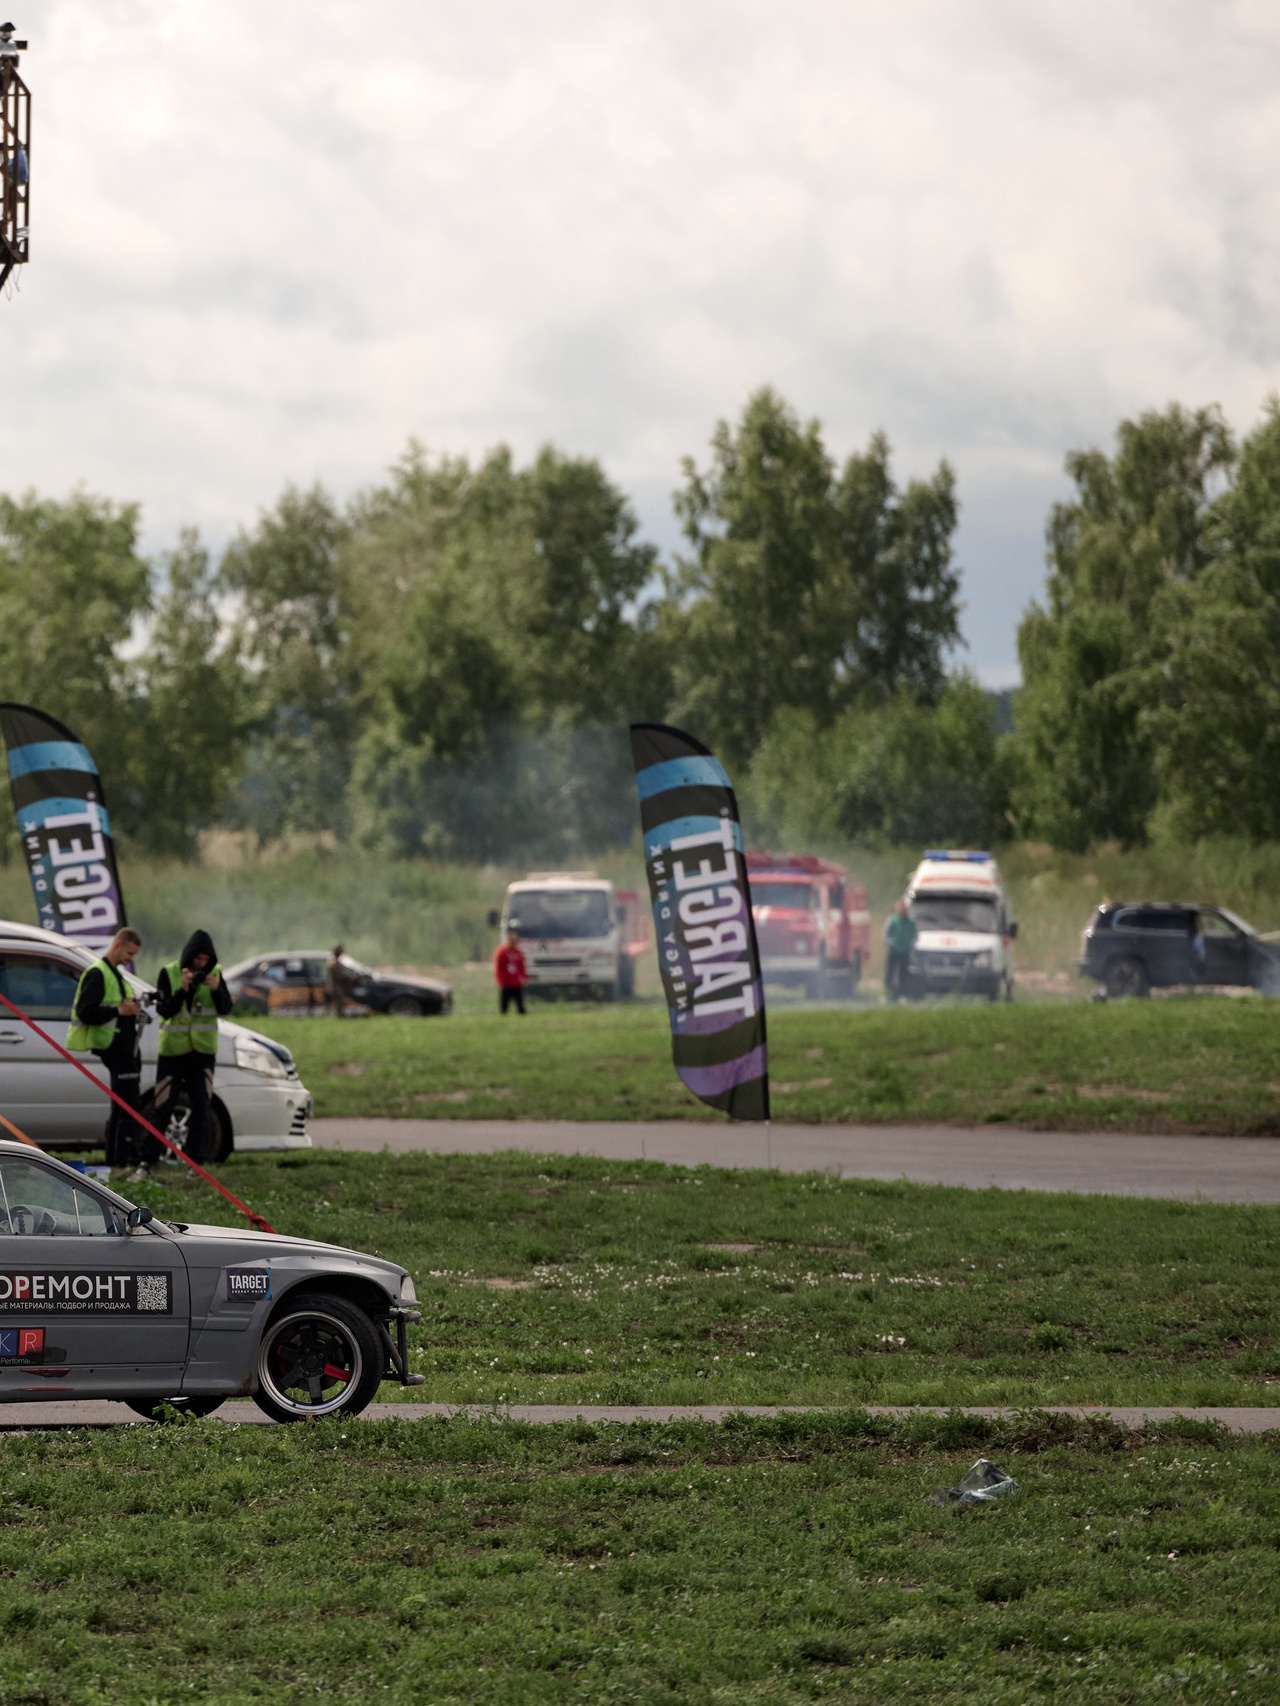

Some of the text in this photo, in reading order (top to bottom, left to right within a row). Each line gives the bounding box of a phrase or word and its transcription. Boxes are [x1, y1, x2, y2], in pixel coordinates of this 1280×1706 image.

[229, 1275, 269, 1289] TARGET
[56, 1302, 87, 1310] ПОДБОР
[94, 1302, 131, 1310] ПРОДАЖА
